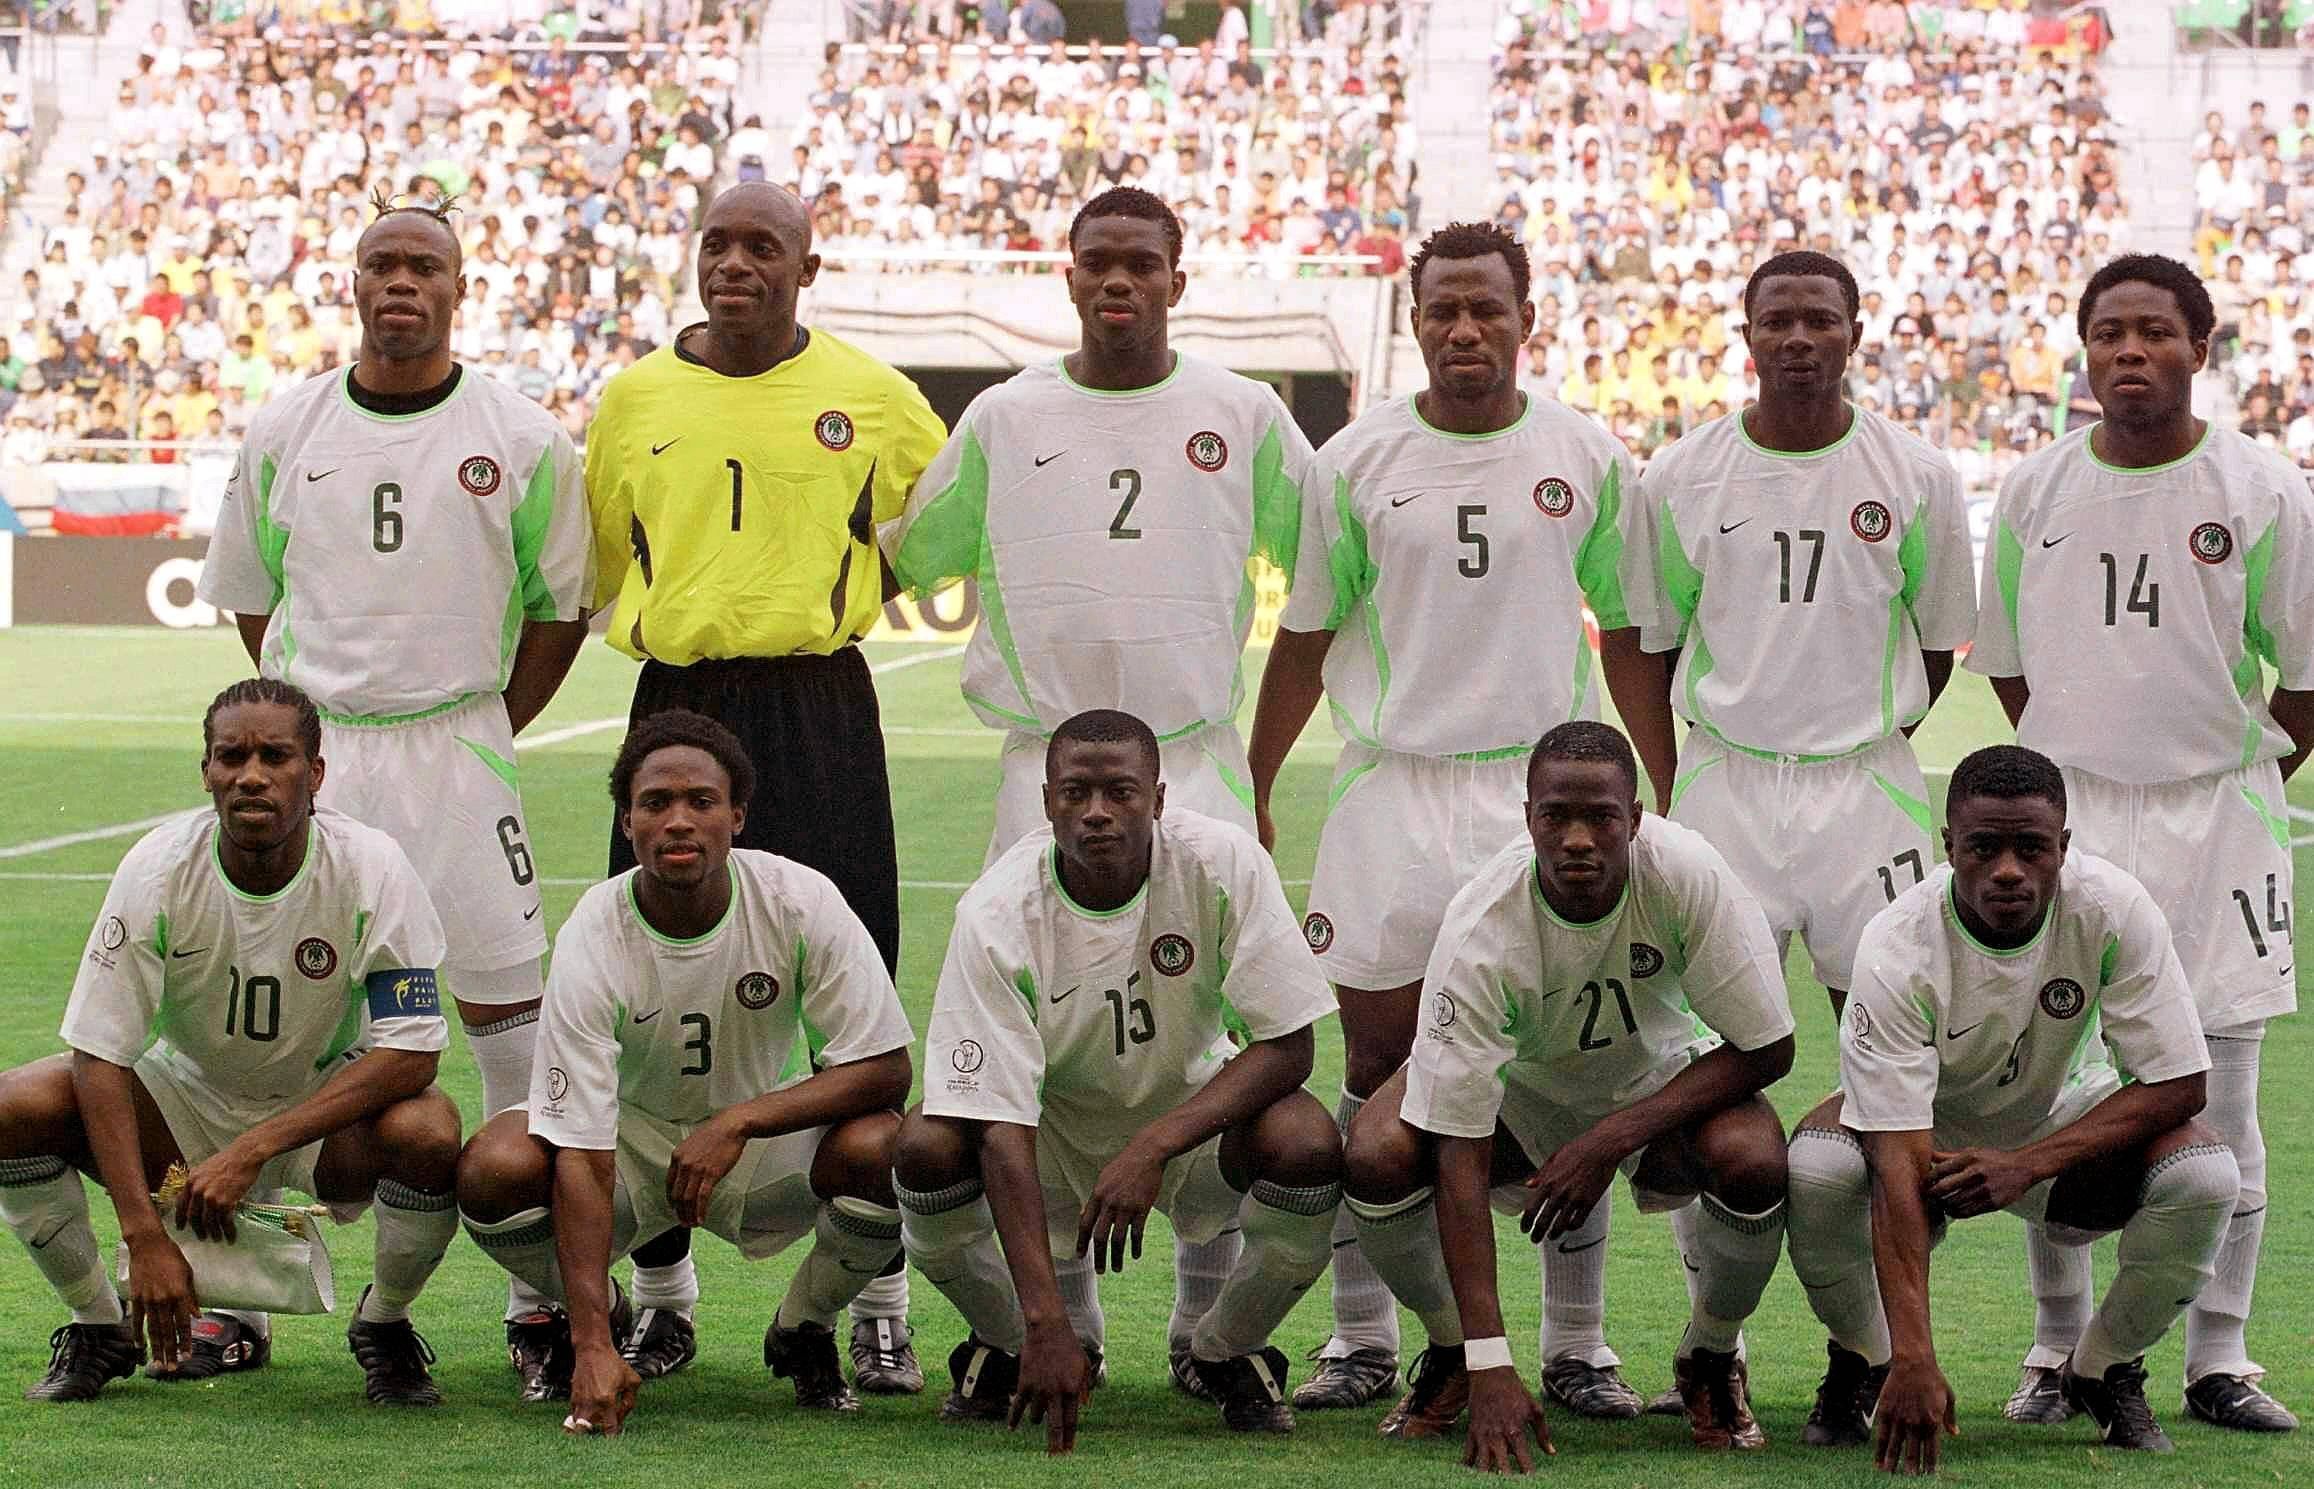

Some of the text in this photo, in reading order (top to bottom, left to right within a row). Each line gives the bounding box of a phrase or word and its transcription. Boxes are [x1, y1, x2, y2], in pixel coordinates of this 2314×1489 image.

[373, 482, 403, 553] 6
[726, 458, 743, 532] 1
[1109, 469, 1142, 540] 2
[1457, 505, 1490, 579] 5
[1773, 530, 1826, 603] 17
[146, 558, 237, 628] a
[2099, 553, 2160, 628] 14
[496, 815, 533, 886] 6
[1877, 848, 1924, 904] 17
[2232, 873, 2292, 958] 14
[226, 965, 281, 1041] 10
[1104, 970, 1156, 1056] 15
[1574, 978, 1638, 1051] 21
[680, 1013, 711, 1076] 3
